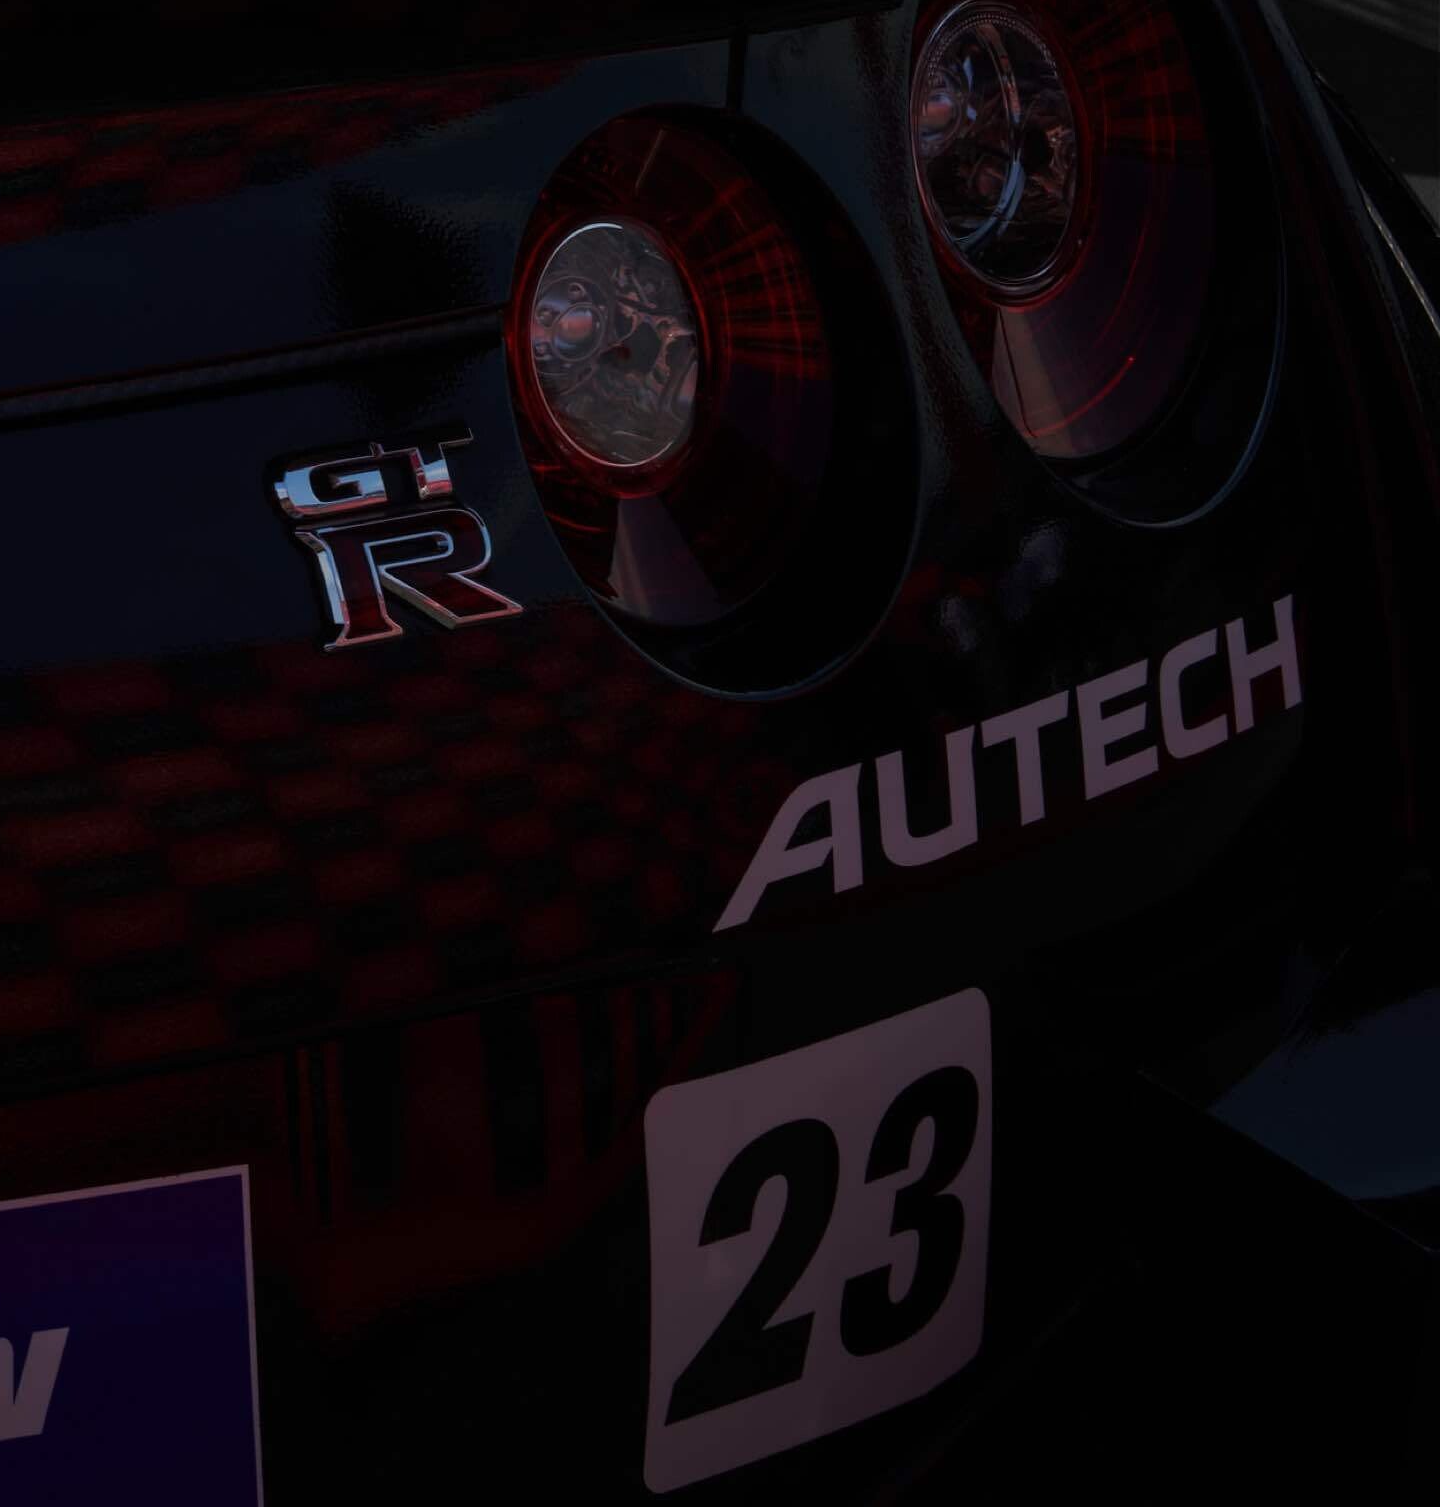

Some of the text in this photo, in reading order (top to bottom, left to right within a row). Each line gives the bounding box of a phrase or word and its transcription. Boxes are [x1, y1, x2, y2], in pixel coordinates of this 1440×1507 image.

[274, 427, 475, 520] GT
[294, 506, 525, 655] R
[712, 593, 1306, 934] AUTECH
[664, 1065, 980, 1427] 23
